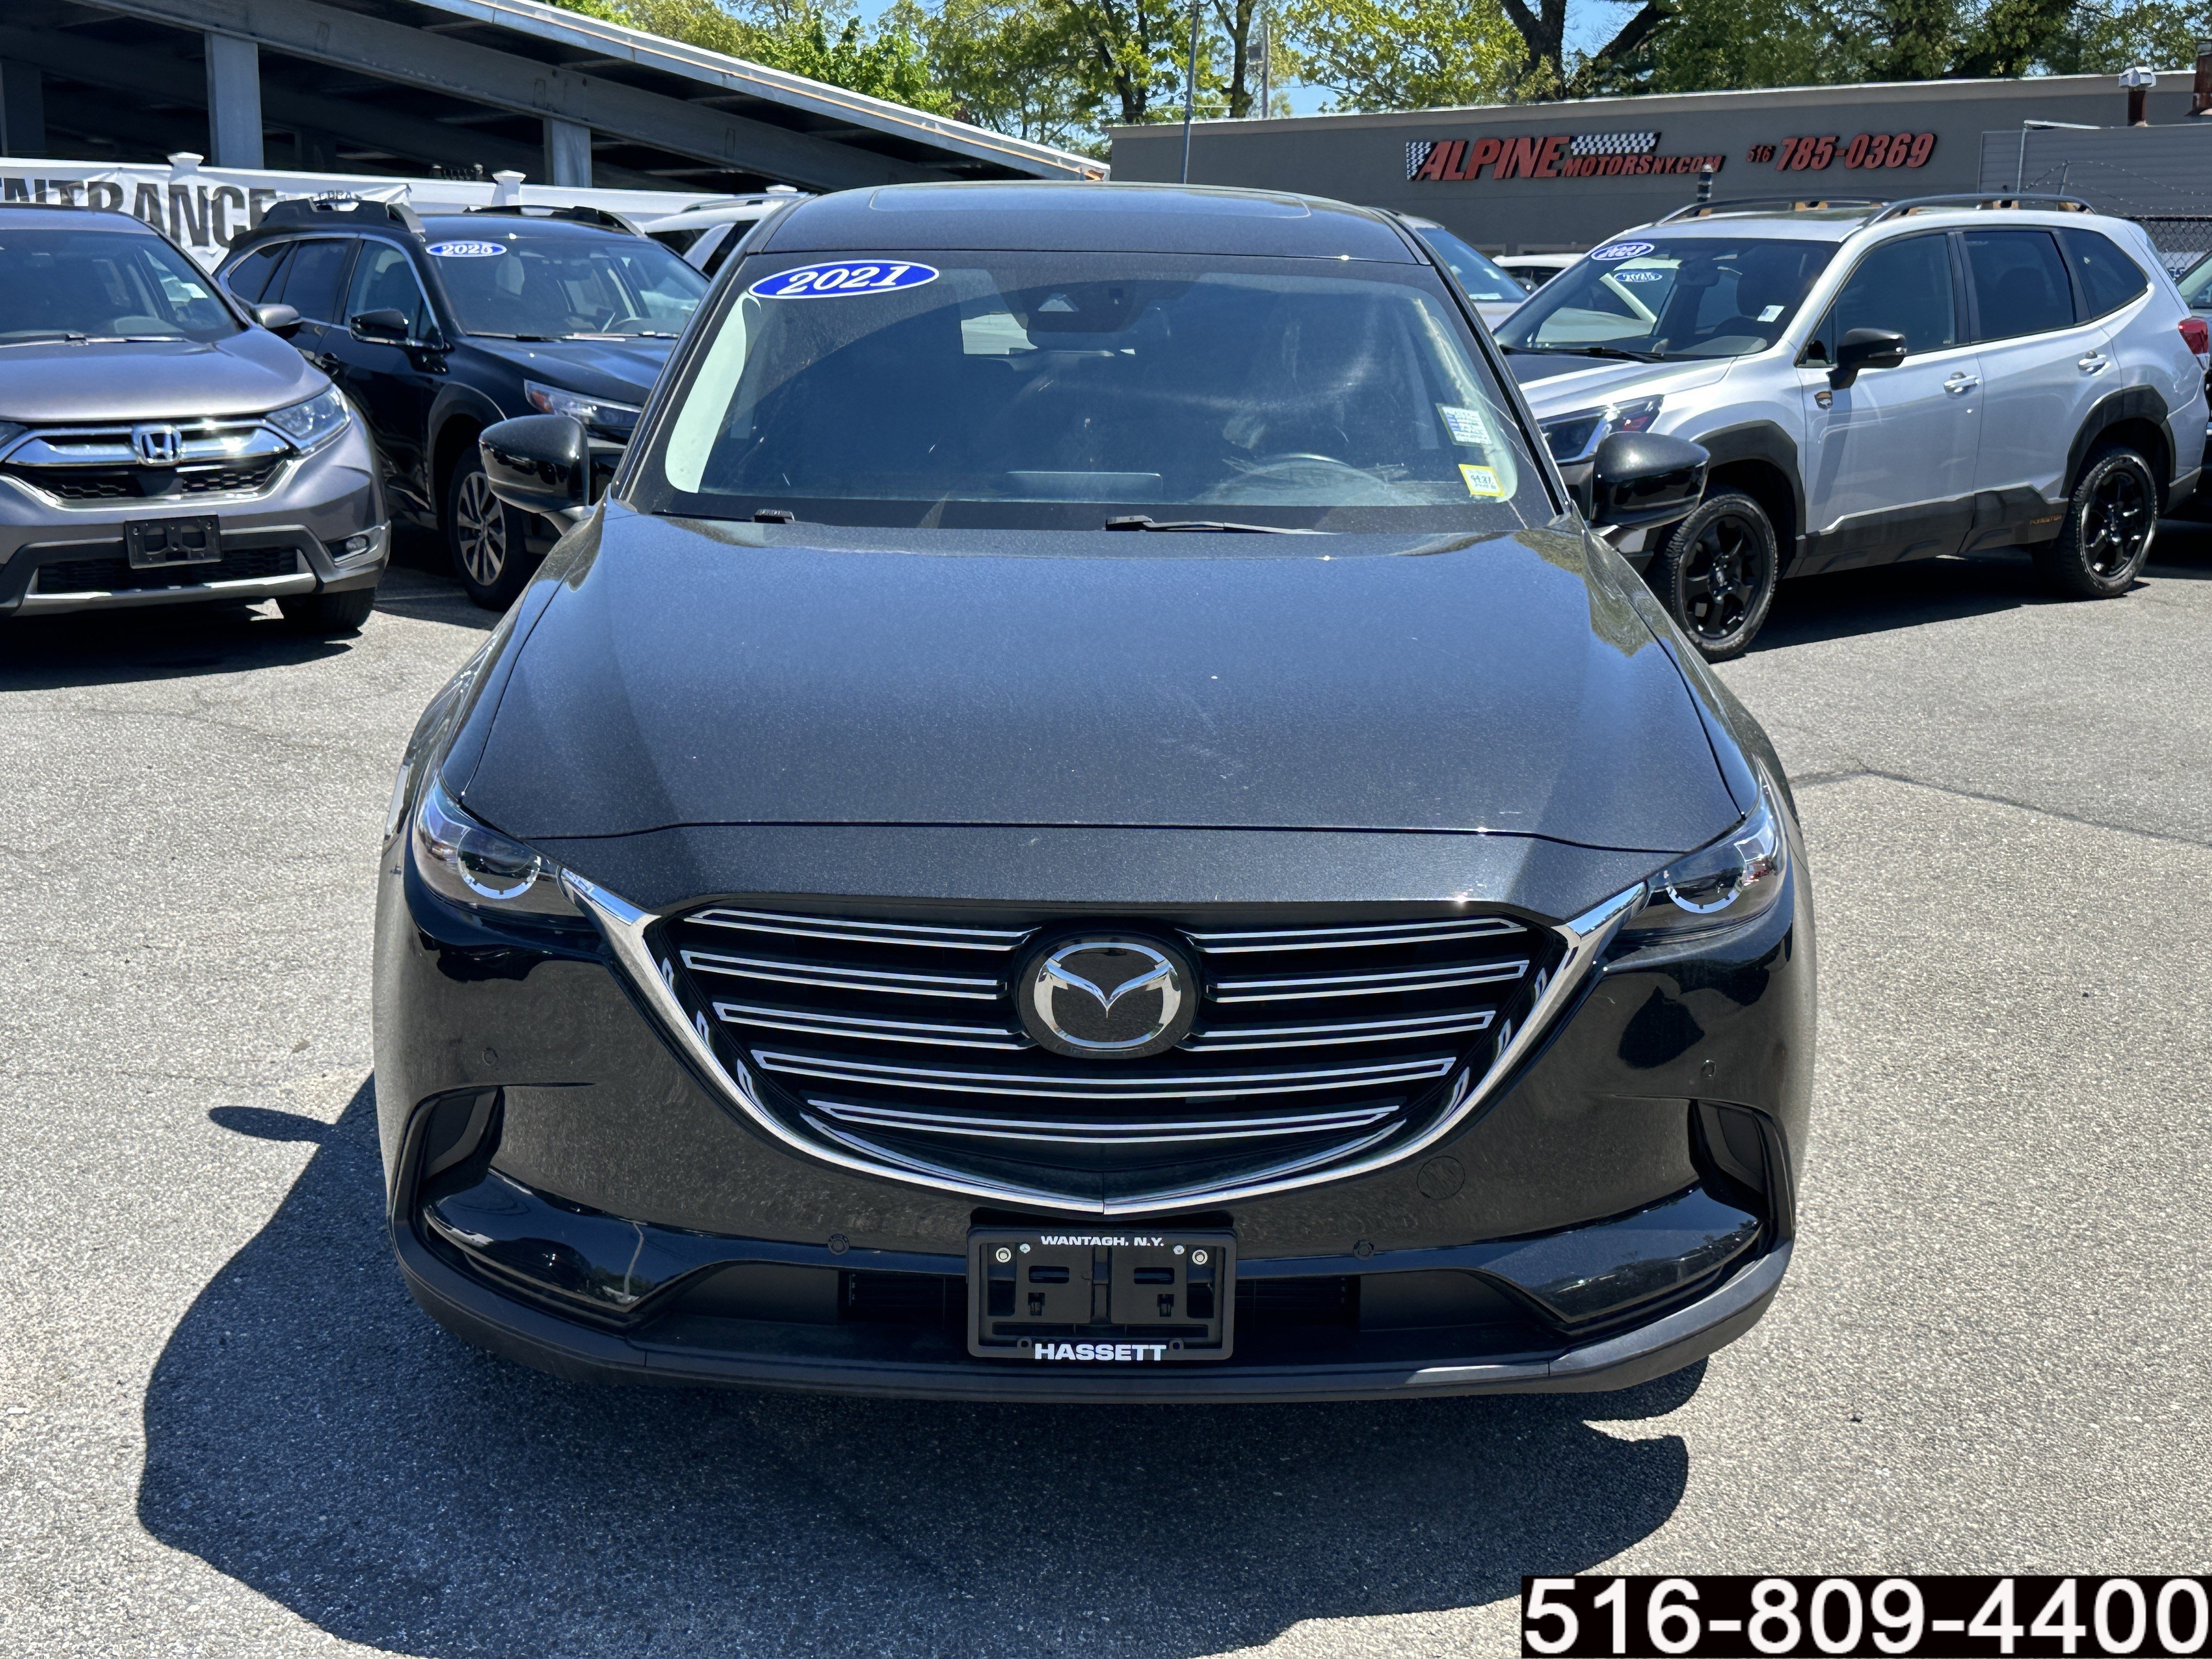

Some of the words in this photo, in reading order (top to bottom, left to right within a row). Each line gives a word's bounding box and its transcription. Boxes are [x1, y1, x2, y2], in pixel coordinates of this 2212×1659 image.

[1415, 136, 1571, 180] ALPINE
[1746, 144, 1774, 162] 516
[1775, 133, 1935, 171] 785-0369
[776, 265, 911, 295] 2021
[1133, 1237, 1165, 1246] N.Y.
[1034, 1343, 1167, 1361] HASSETT
